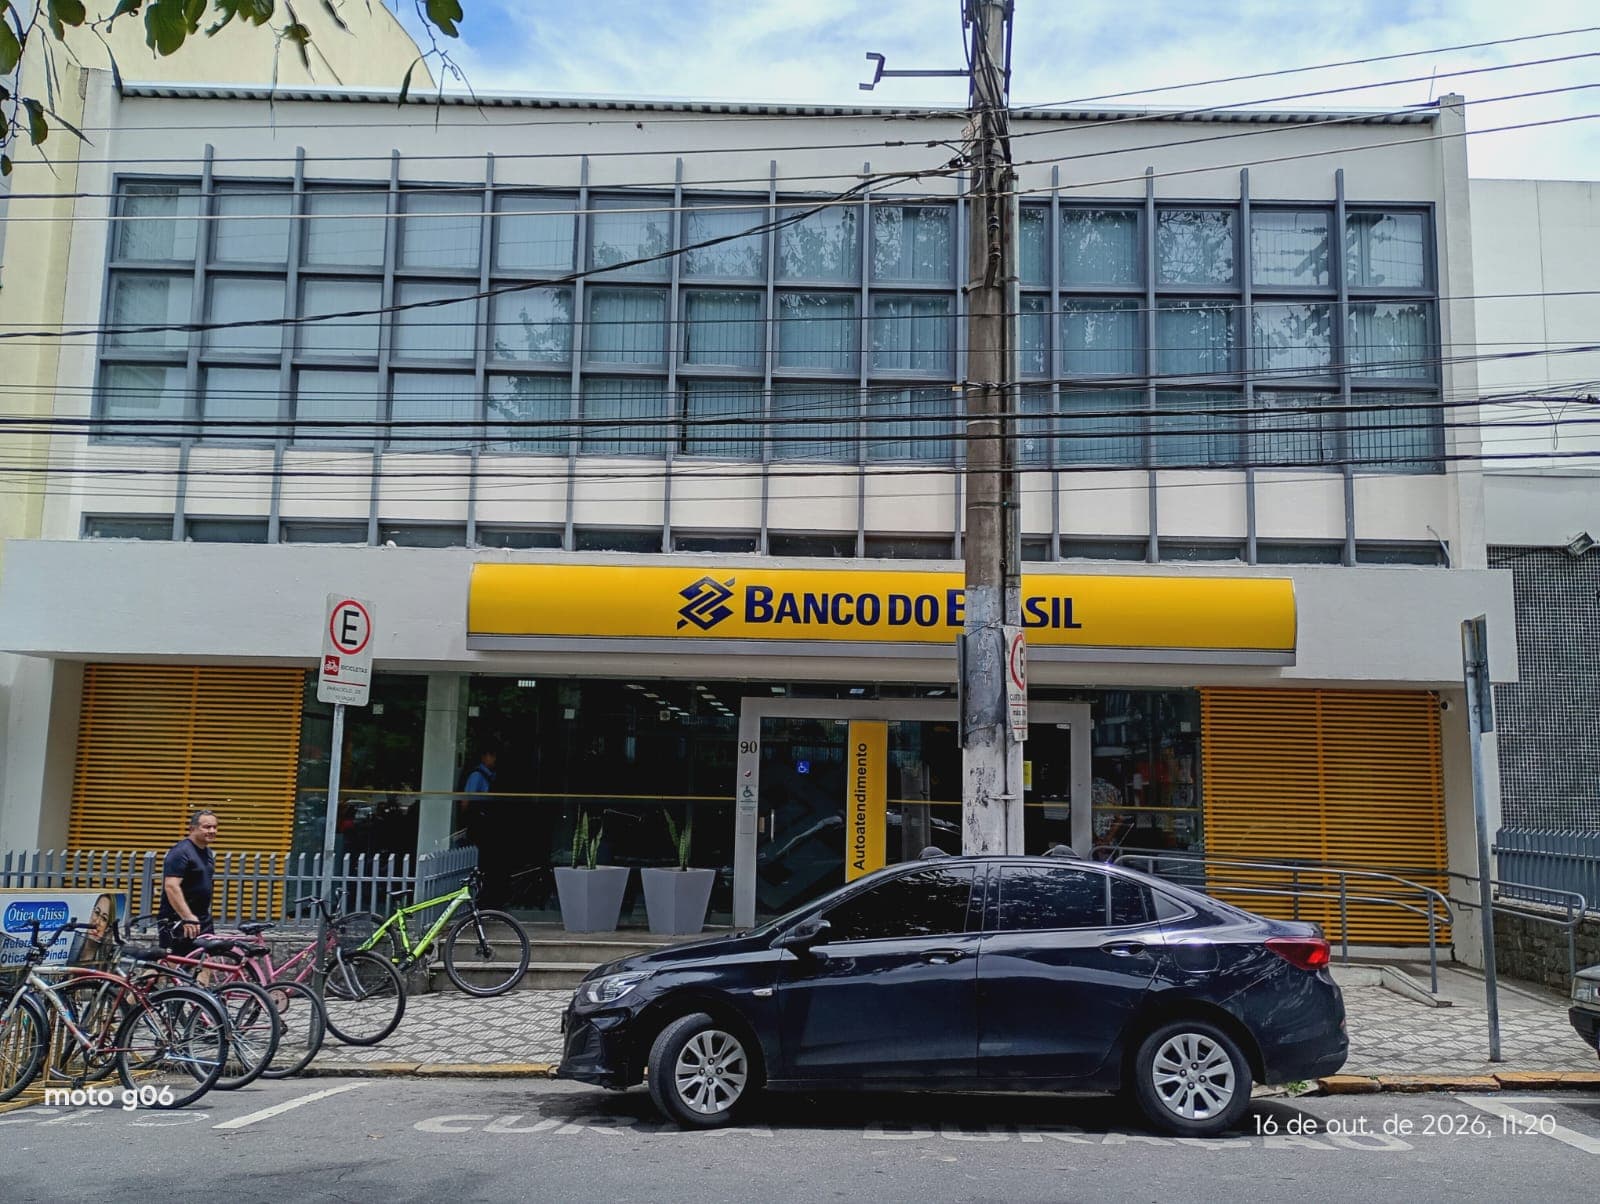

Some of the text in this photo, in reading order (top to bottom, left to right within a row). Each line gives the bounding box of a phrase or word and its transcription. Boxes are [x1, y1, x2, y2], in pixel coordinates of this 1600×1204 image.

[744, 586, 1082, 628] BANCO DO BSIL
[341, 609, 360, 646] E
[740, 741, 758, 754] 90
[853, 742, 868, 871] Autoatendimento
[8, 904, 66, 921] Ótica Ghissi
